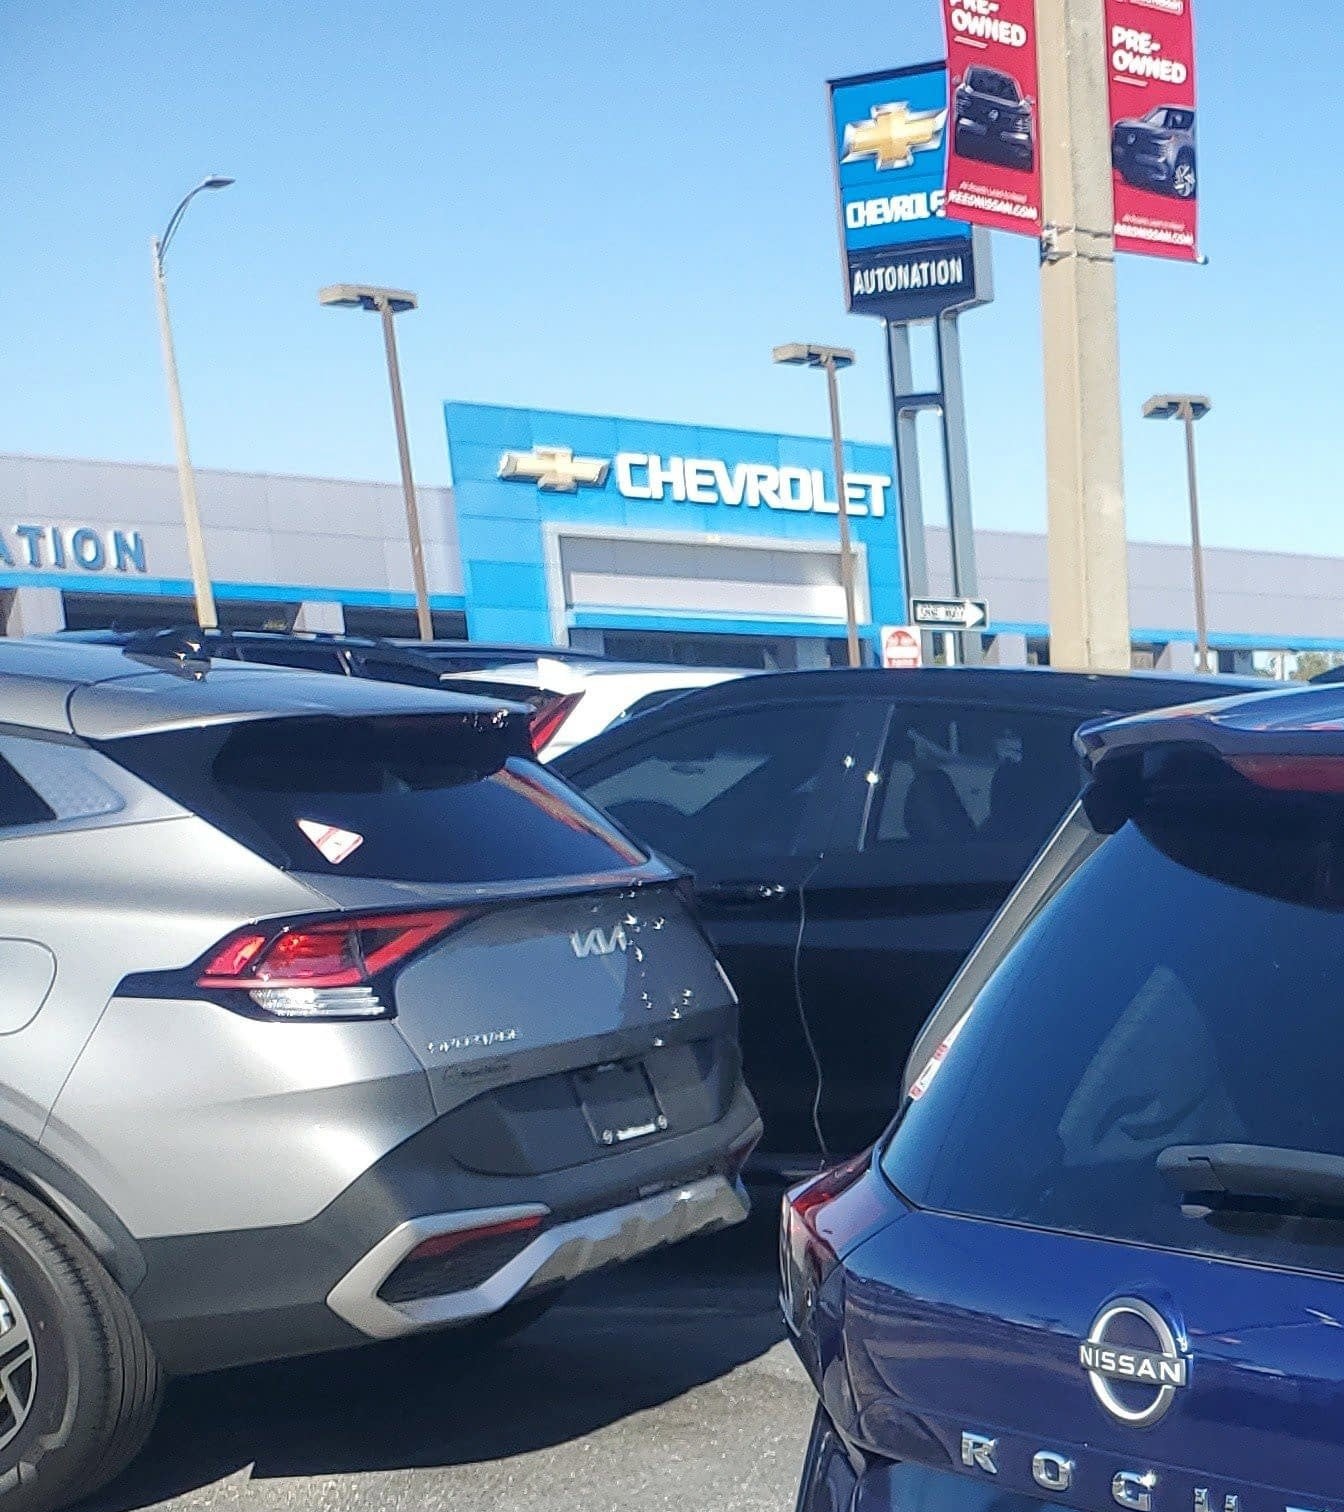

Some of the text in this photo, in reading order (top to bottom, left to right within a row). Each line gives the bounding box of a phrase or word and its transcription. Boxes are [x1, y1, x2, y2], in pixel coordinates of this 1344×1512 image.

[949, 0, 999, 15] RE-
[951, 8, 1027, 47] OWNED
[1112, 26, 1160, 55] PRE-
[1112, 50, 1187, 84] OWNED
[846, 190, 947, 229] CHEVROLE
[853, 257, 963, 296] AUTONATION
[615, 452, 891, 518] CHEVROLET
[1080, 1345, 1181, 1383] NISSAN
